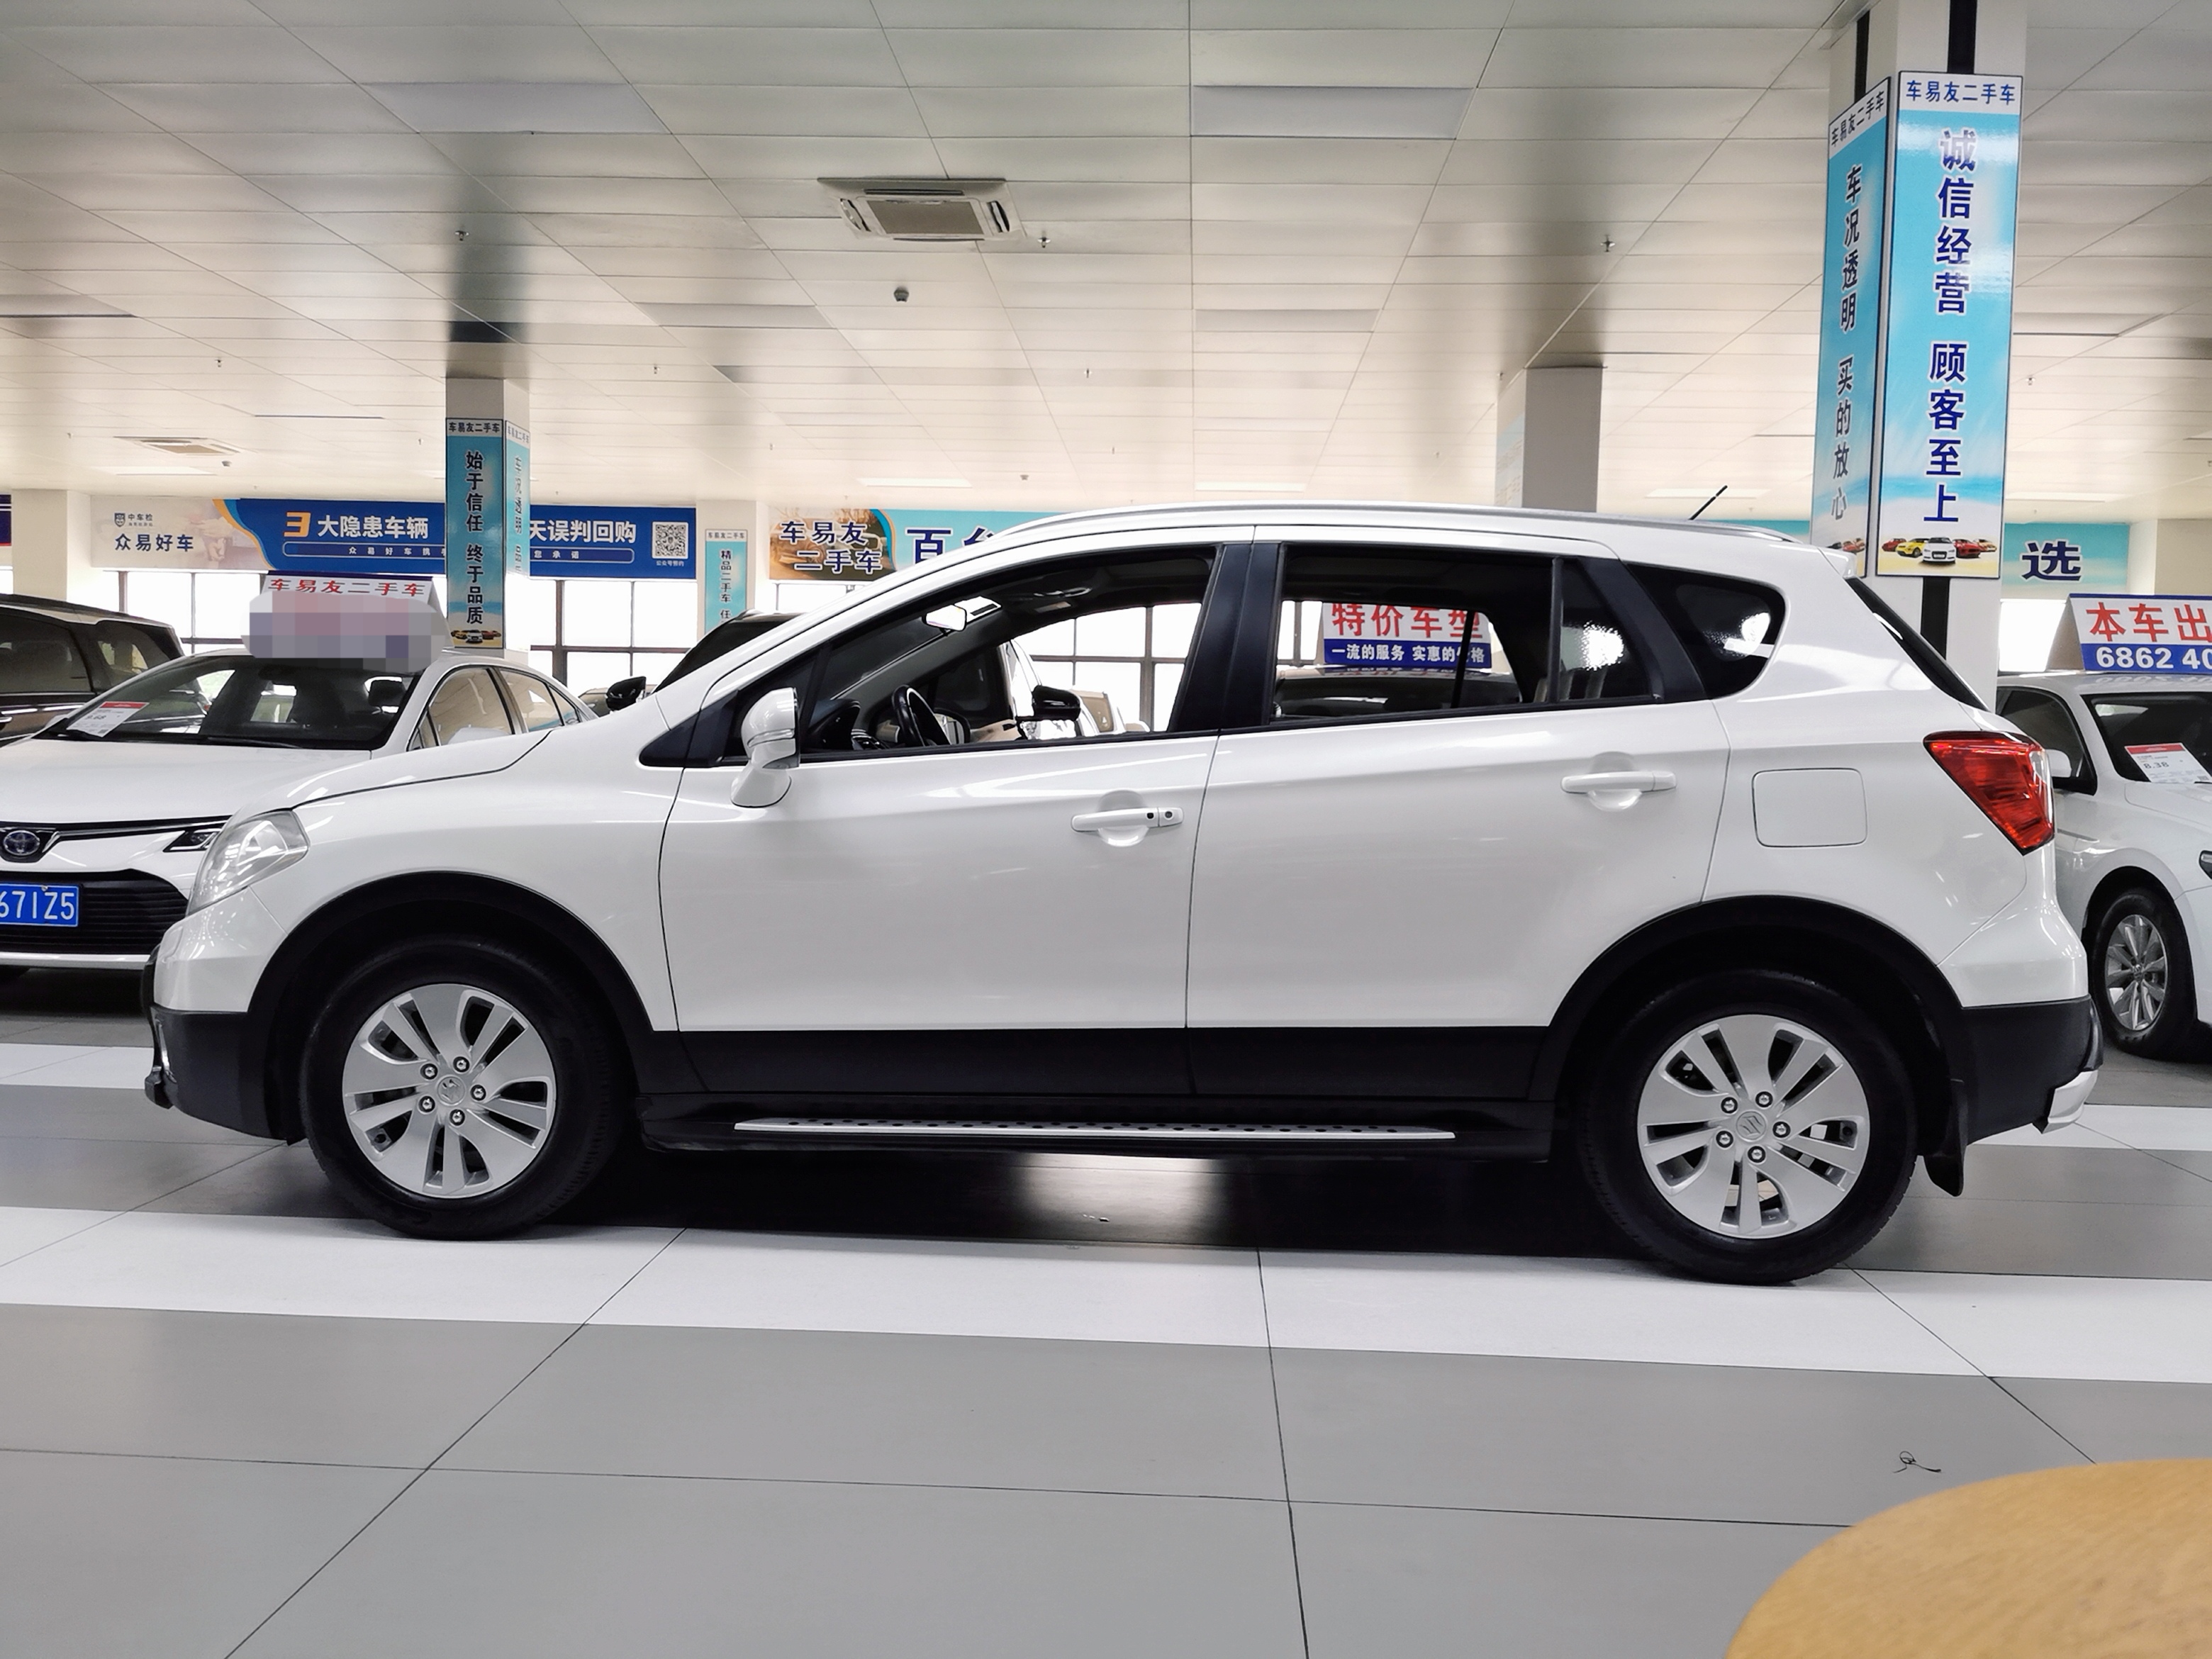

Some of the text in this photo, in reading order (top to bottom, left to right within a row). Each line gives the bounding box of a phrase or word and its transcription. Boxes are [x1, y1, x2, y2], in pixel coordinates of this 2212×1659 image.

[1906, 80, 2016, 105] 车易友二手车
[1831, 90, 1884, 147] 车易友二手车
[1923, 128, 1977, 522] 诚信经营 顾客至上
[1831, 164, 1862, 520] 车况透明 买的放心
[449, 422, 500, 432] 车易友二手车
[115, 533, 194, 552] 众易好车
[465, 450, 484, 625] 始于信任 终于品质
[530, 520, 637, 543] 天误判回购
[780, 520, 868, 544] 车易友
[795, 549, 882, 573] 二手车
[2021, 541, 2082, 581] 选
[267, 578, 426, 597] 车易友二手车
[720, 549, 732, 603] 精品二手车
[1331, 603, 1483, 638] 特价车型
[2086, 601, 2212, 642] 本车出
[1331, 644, 1485, 664] 一流的服务 实惠的格
[2096, 646, 2174, 669] 6862
